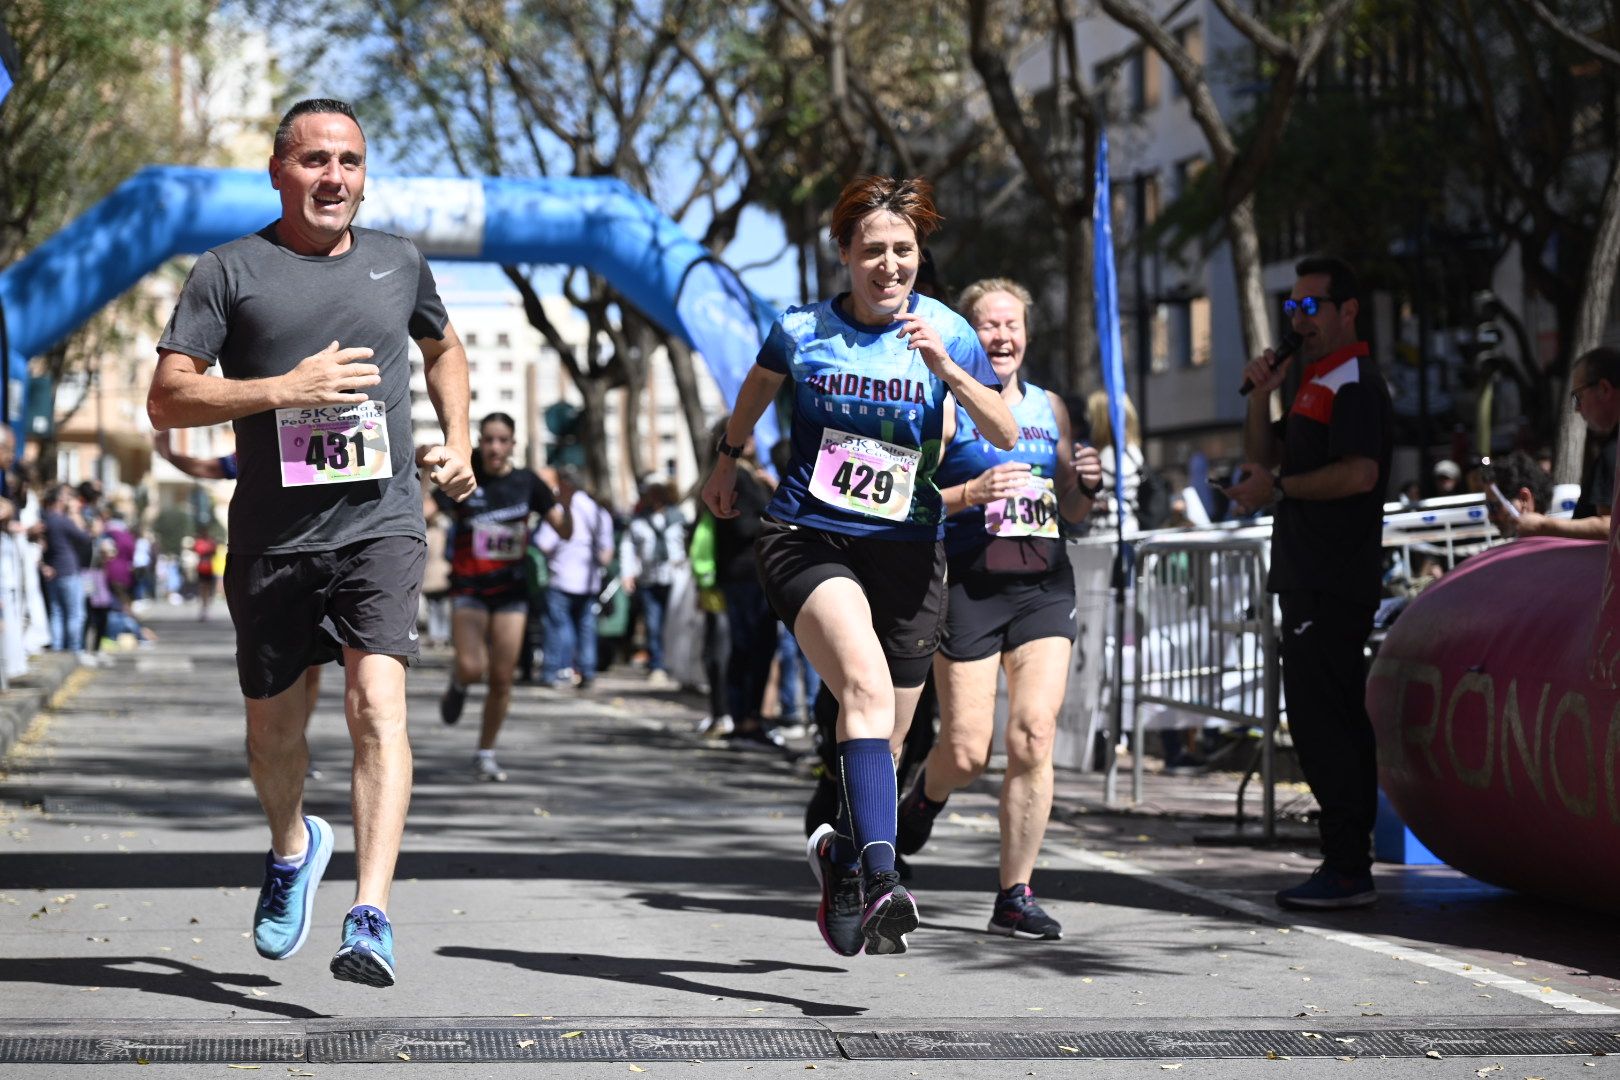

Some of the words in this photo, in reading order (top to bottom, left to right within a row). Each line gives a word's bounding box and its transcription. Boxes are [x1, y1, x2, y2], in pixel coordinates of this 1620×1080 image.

[301, 407, 328, 418] 5K
[815, 397, 917, 420] runners
[305, 432, 365, 470] 431
[844, 435, 867, 449] 5K
[832, 461, 894, 504] 429
[1002, 497, 1047, 526] 430
